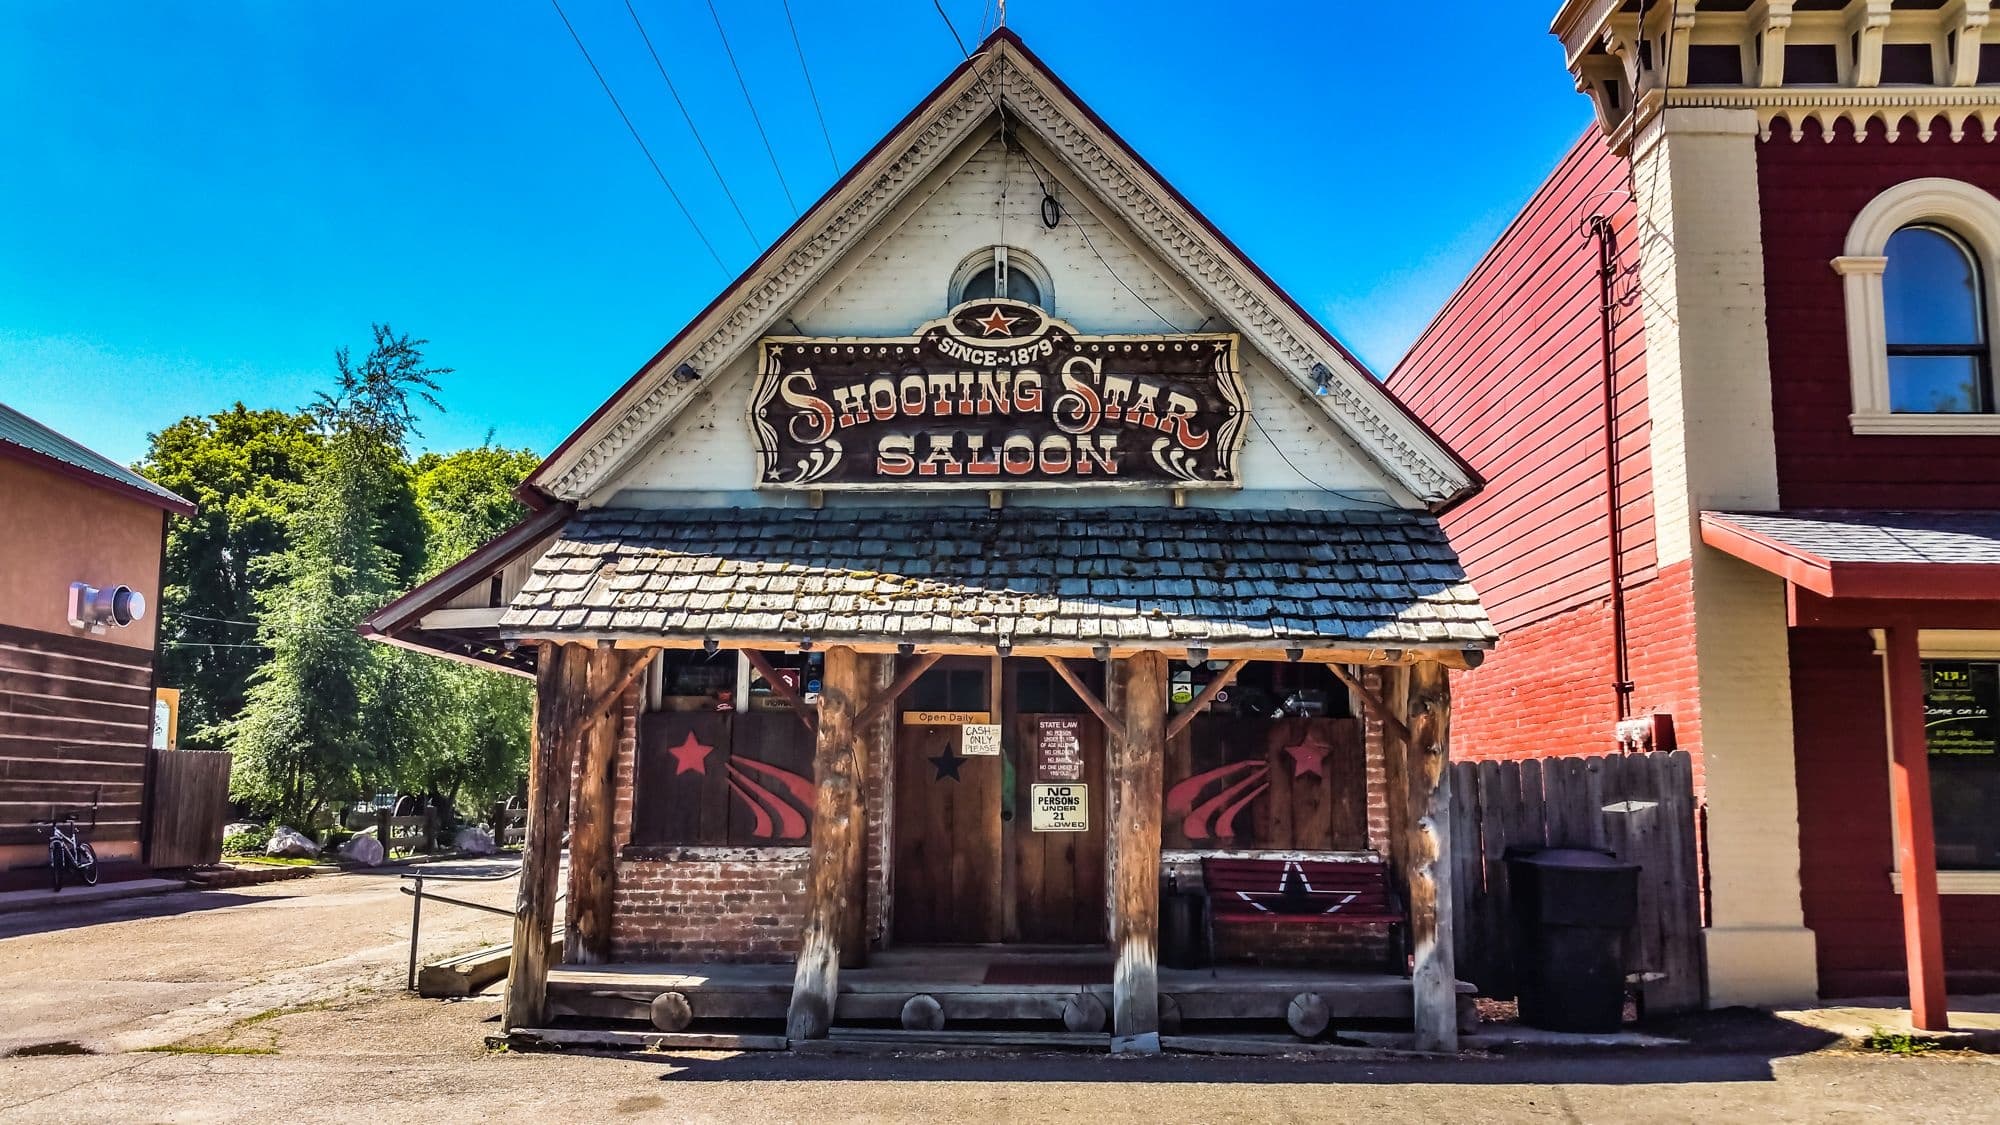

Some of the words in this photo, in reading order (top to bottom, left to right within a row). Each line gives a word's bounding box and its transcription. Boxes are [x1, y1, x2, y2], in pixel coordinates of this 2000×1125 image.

[782, 368, 1044, 445] SHOOTING
[1052, 354, 1210, 450] STAR
[876, 434, 1119, 477] SALOON
[1975, 705, 1987, 715] in
[919, 712, 946, 723] Open
[949, 713, 974, 723] Daily
[1039, 721, 1061, 729] STATE
[1062, 721, 1078, 729] LAW
[965, 726, 990, 736] CASH
[970, 735, 993, 745] ONLY
[965, 744, 997, 753] PLEASE
[1047, 787, 1071, 796] NO
[1038, 796, 1080, 805] PERSONS
[1053, 812, 1065, 821] 21
